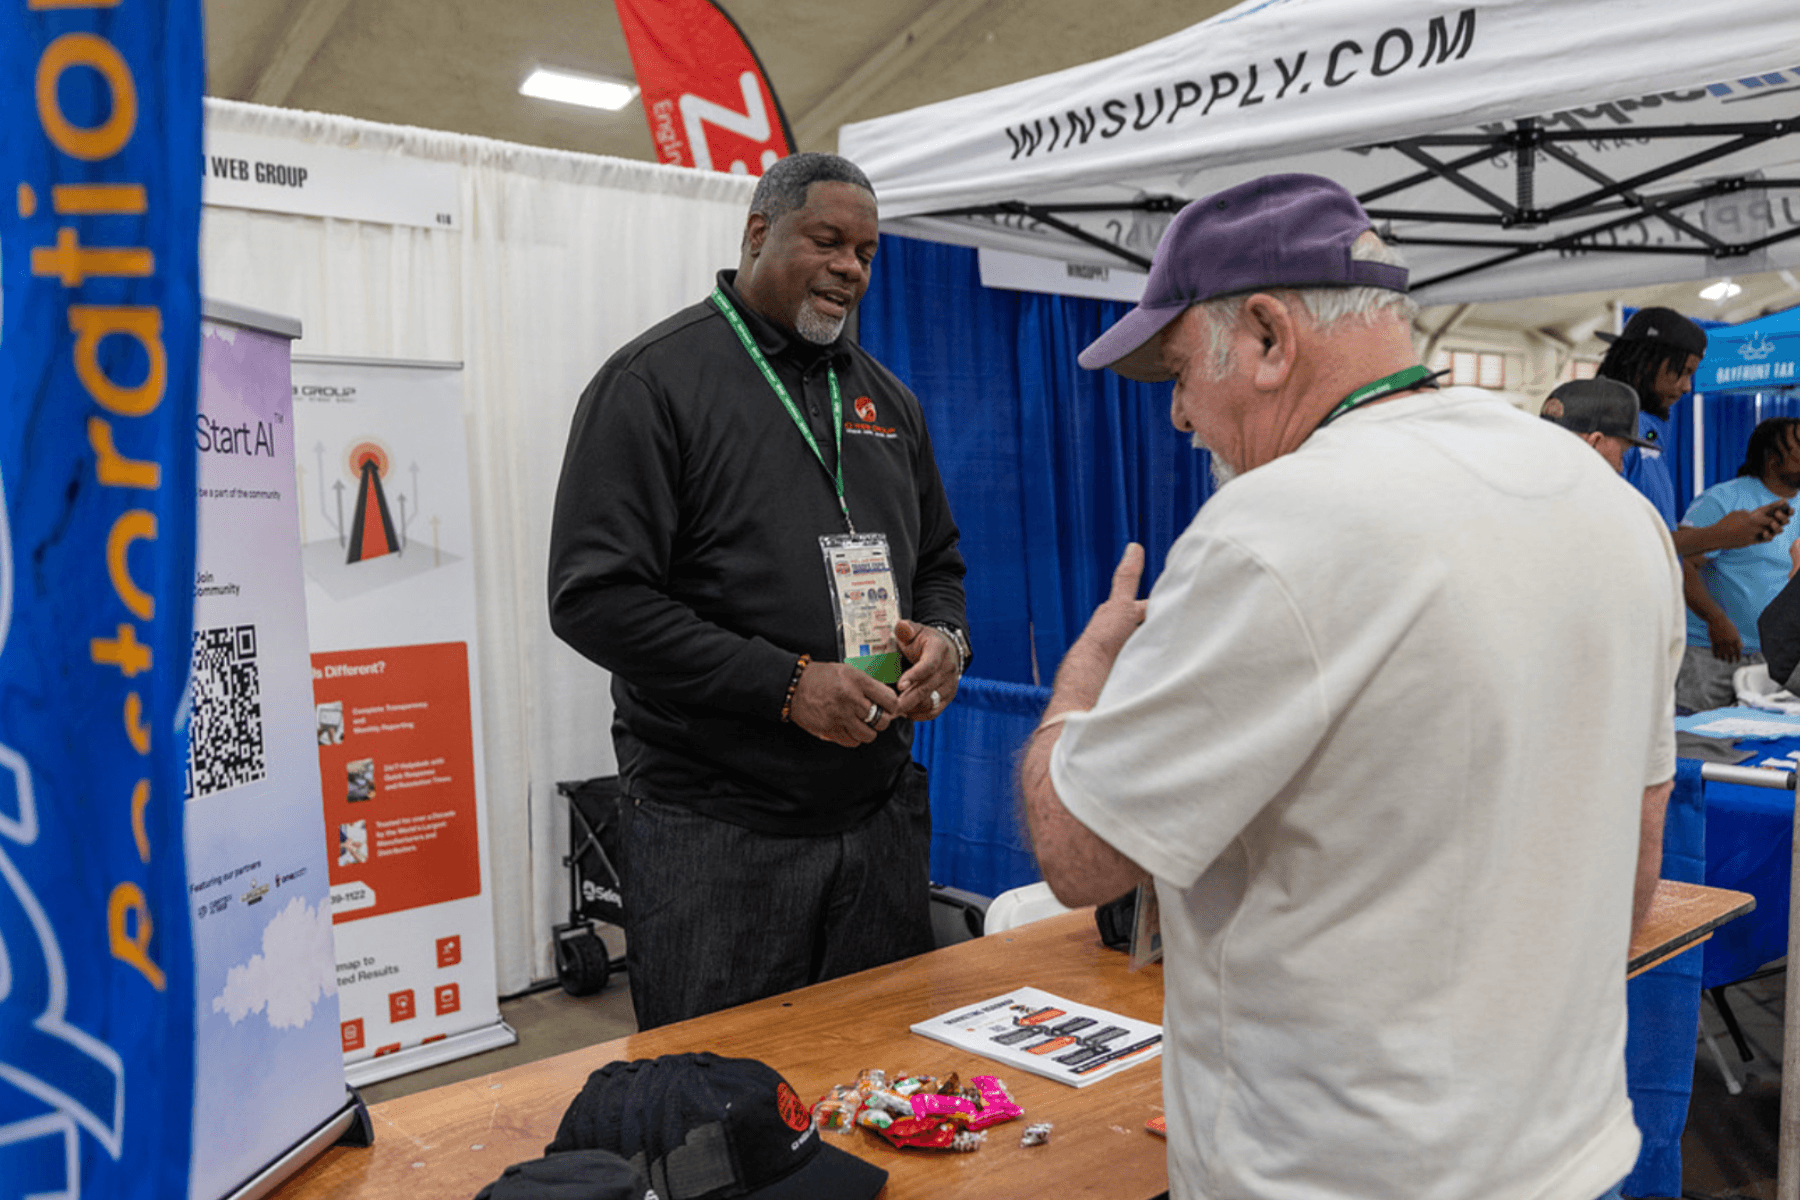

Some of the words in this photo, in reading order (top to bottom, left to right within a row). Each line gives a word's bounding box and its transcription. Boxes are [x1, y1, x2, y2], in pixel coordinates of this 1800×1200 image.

[1005, 8, 1477, 160] WINSUPPLY.COM
[211, 155, 250, 181] WEB
[255, 161, 308, 188] GROUP
[195, 413, 252, 456] Start
[254, 420, 275, 458] AI
[325, 660, 387, 680] Different?
[358, 964, 400, 982] Results
